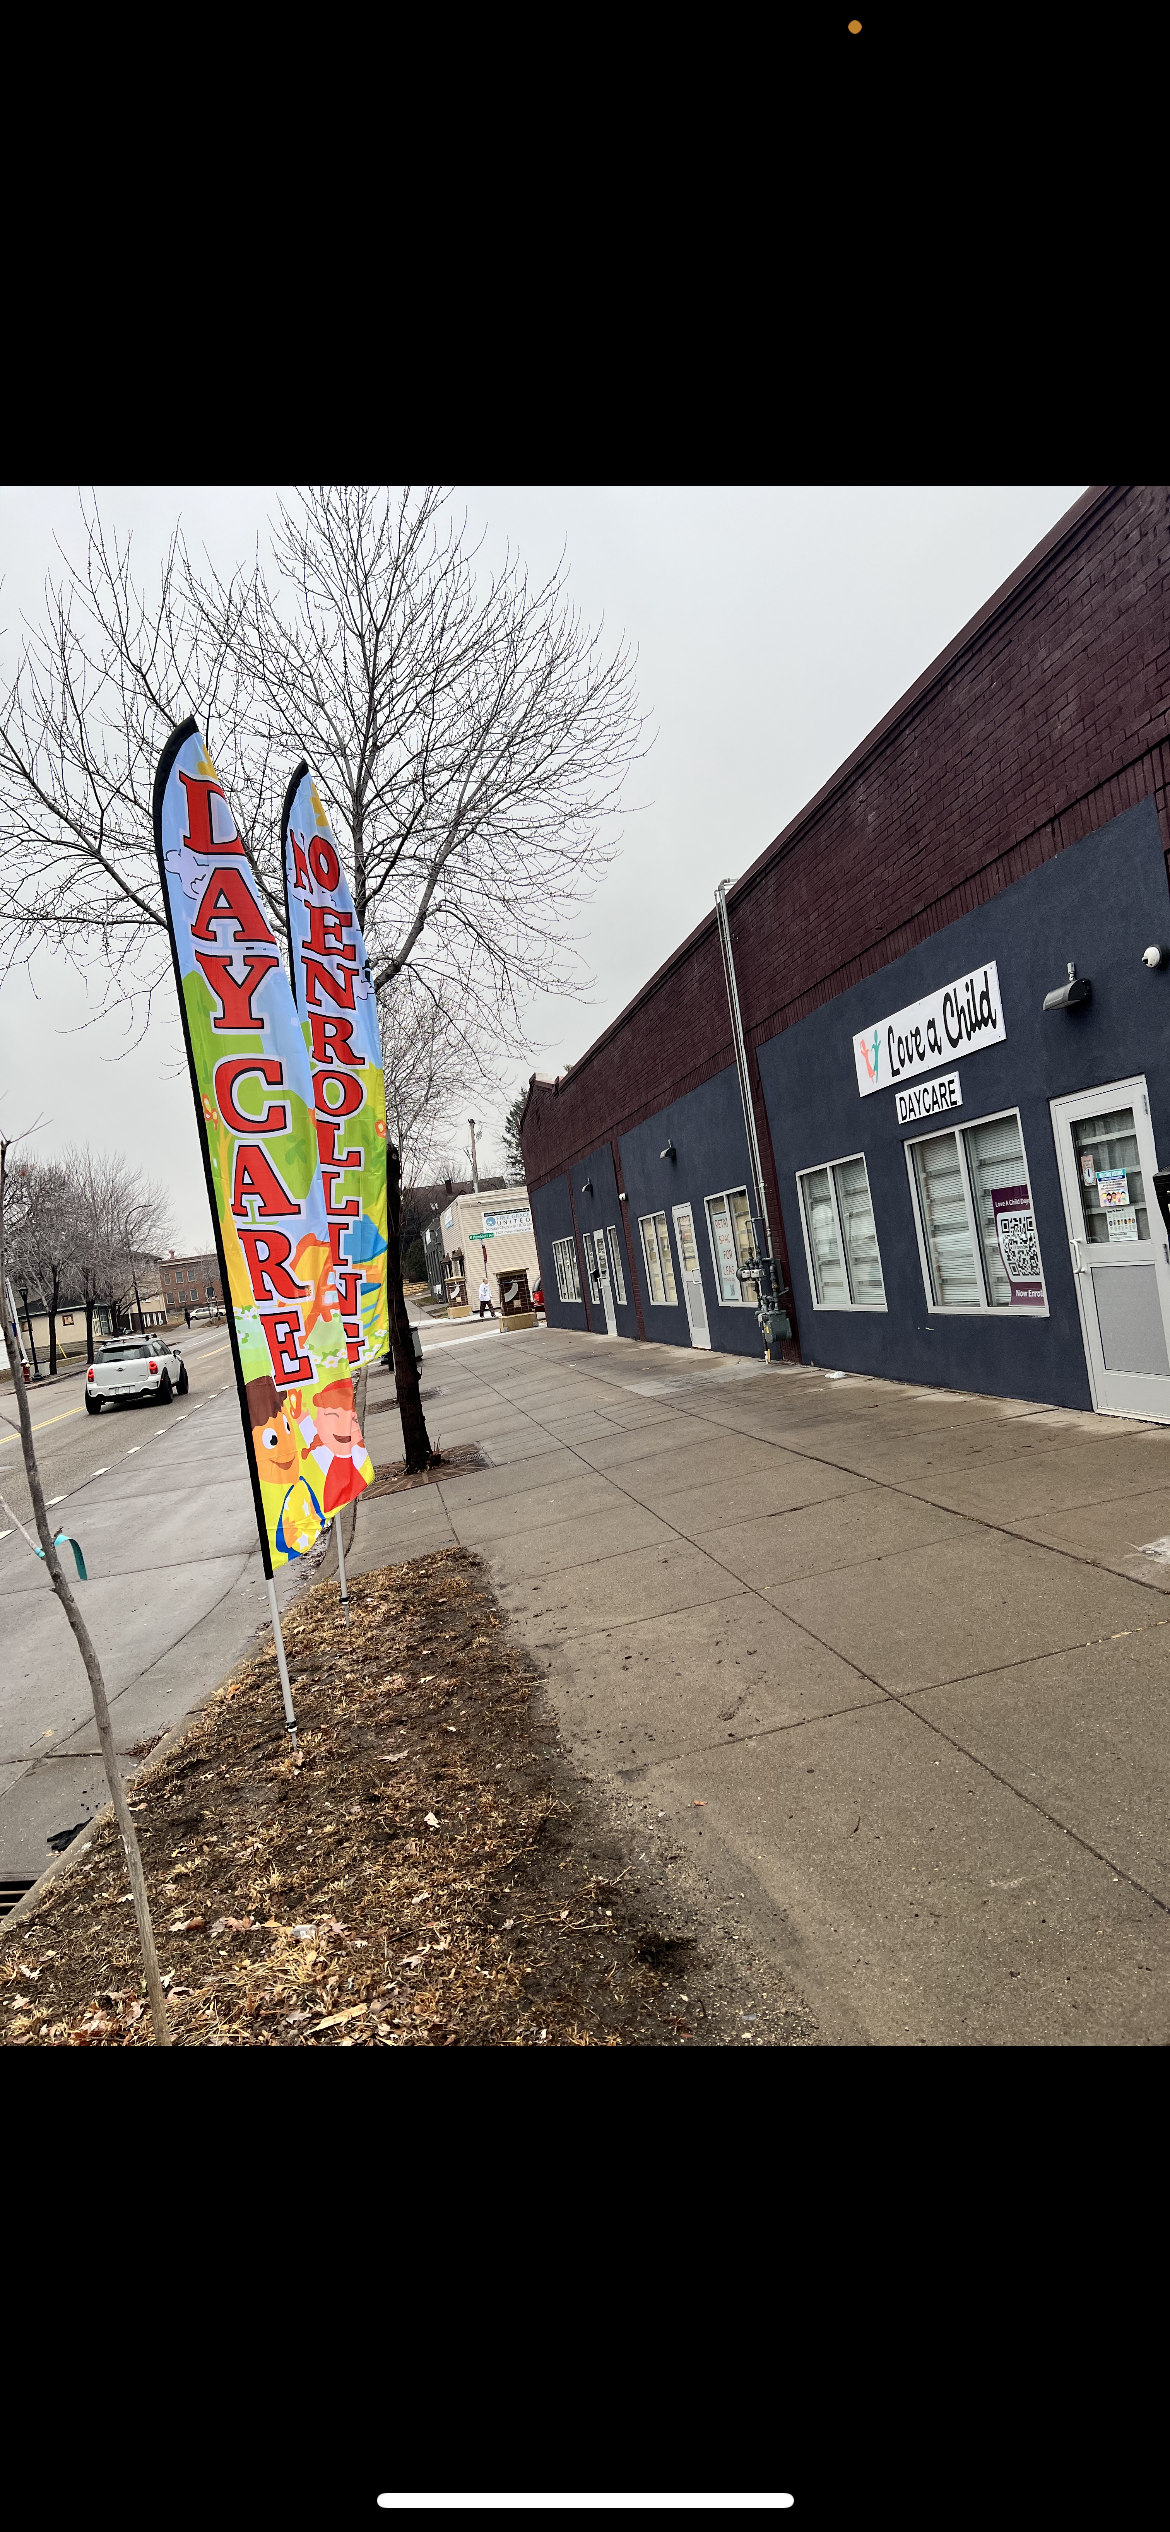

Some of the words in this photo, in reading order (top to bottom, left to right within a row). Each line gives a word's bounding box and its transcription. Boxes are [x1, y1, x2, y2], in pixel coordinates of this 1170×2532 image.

[179, 770, 279, 1033] DAY
[887, 1025, 926, 1077] Love
[926, 1017, 943, 1055] a
[942, 970, 997, 1048] Child
[898, 1079, 958, 1121] DAYCARE
[214, 1058, 314, 1388] CARE
[496, 1217, 531, 1226] UNITED
[715, 1218, 728, 1229] RETAI
[719, 1234, 730, 1244] SPAC
[723, 1266, 735, 1275] LEAS
[1015, 1289, 1027, 1297] Now
